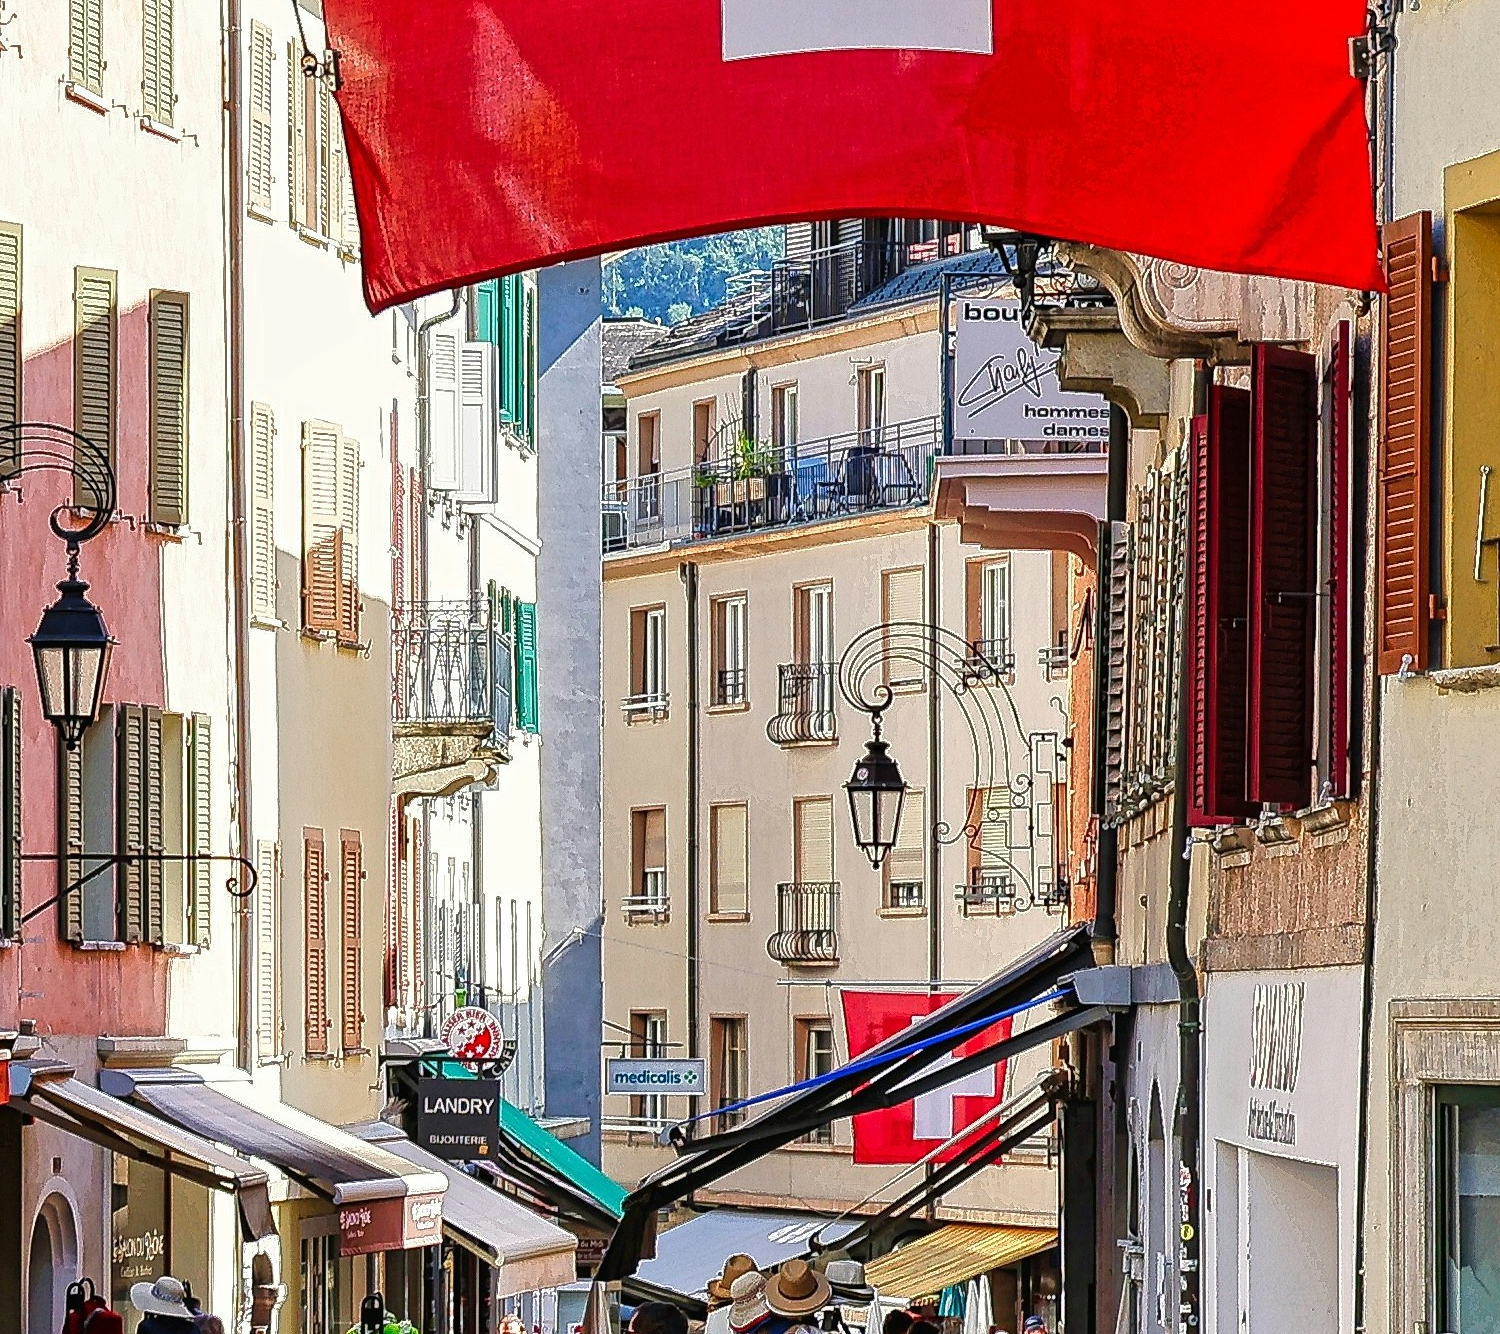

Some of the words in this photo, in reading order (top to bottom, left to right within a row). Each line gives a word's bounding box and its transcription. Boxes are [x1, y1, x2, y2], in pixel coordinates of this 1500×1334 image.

[964, 302, 1021, 322] bou
[1024, 404, 1111, 419] hommes
[1042, 422, 1111, 437] dames
[614, 1069, 682, 1085] medicalis
[423, 1096, 495, 1116] LANDRY
[429, 1134, 488, 1146] BIJOUTERIE
